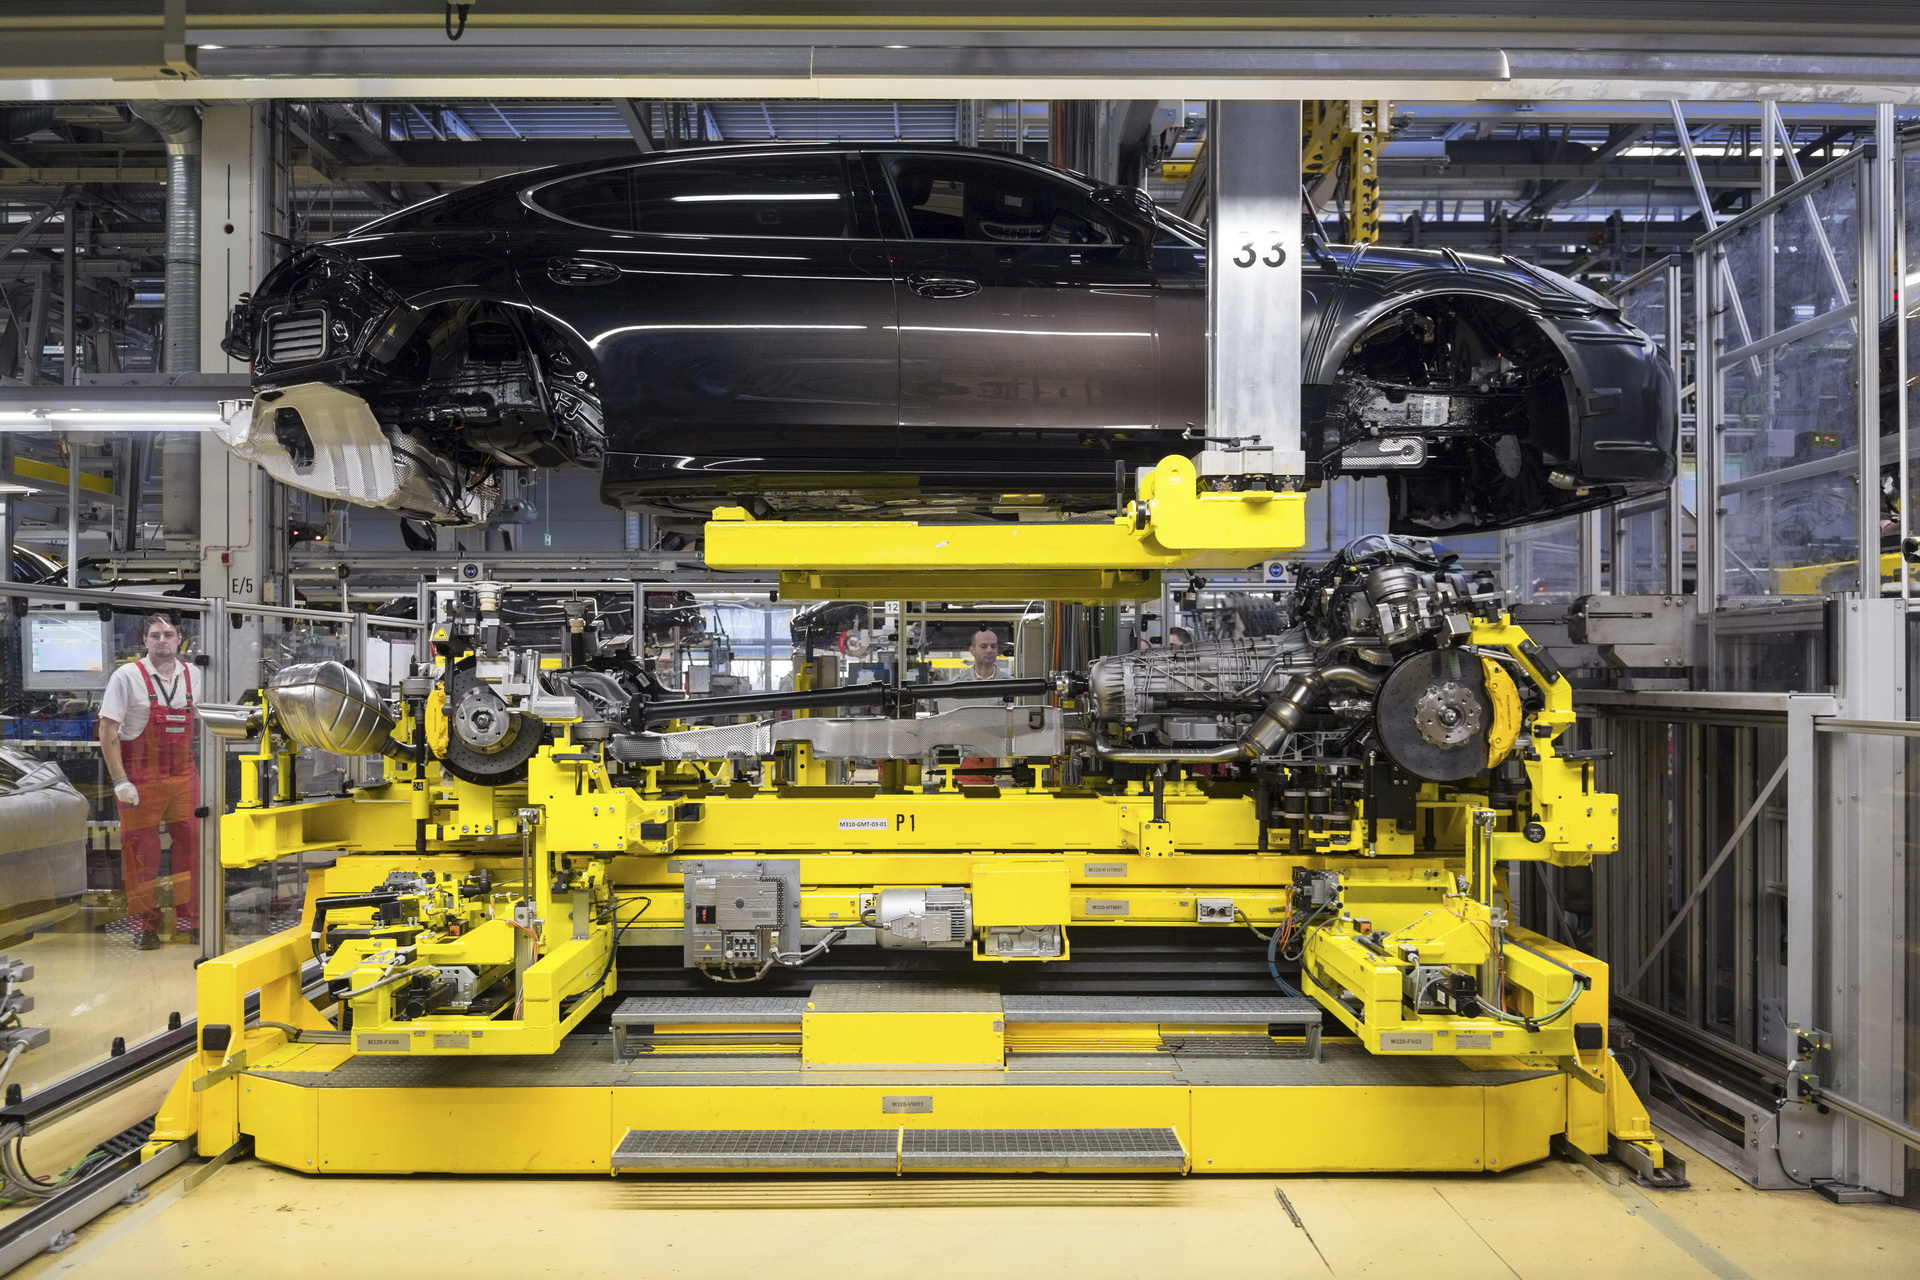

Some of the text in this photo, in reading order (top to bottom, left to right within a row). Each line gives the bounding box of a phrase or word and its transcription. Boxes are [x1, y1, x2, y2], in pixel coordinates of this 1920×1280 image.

[1232, 231, 1287, 268] 33
[232, 576, 253, 595] E/5
[887, 602, 899, 611] 12
[413, 782, 423, 790] 24
